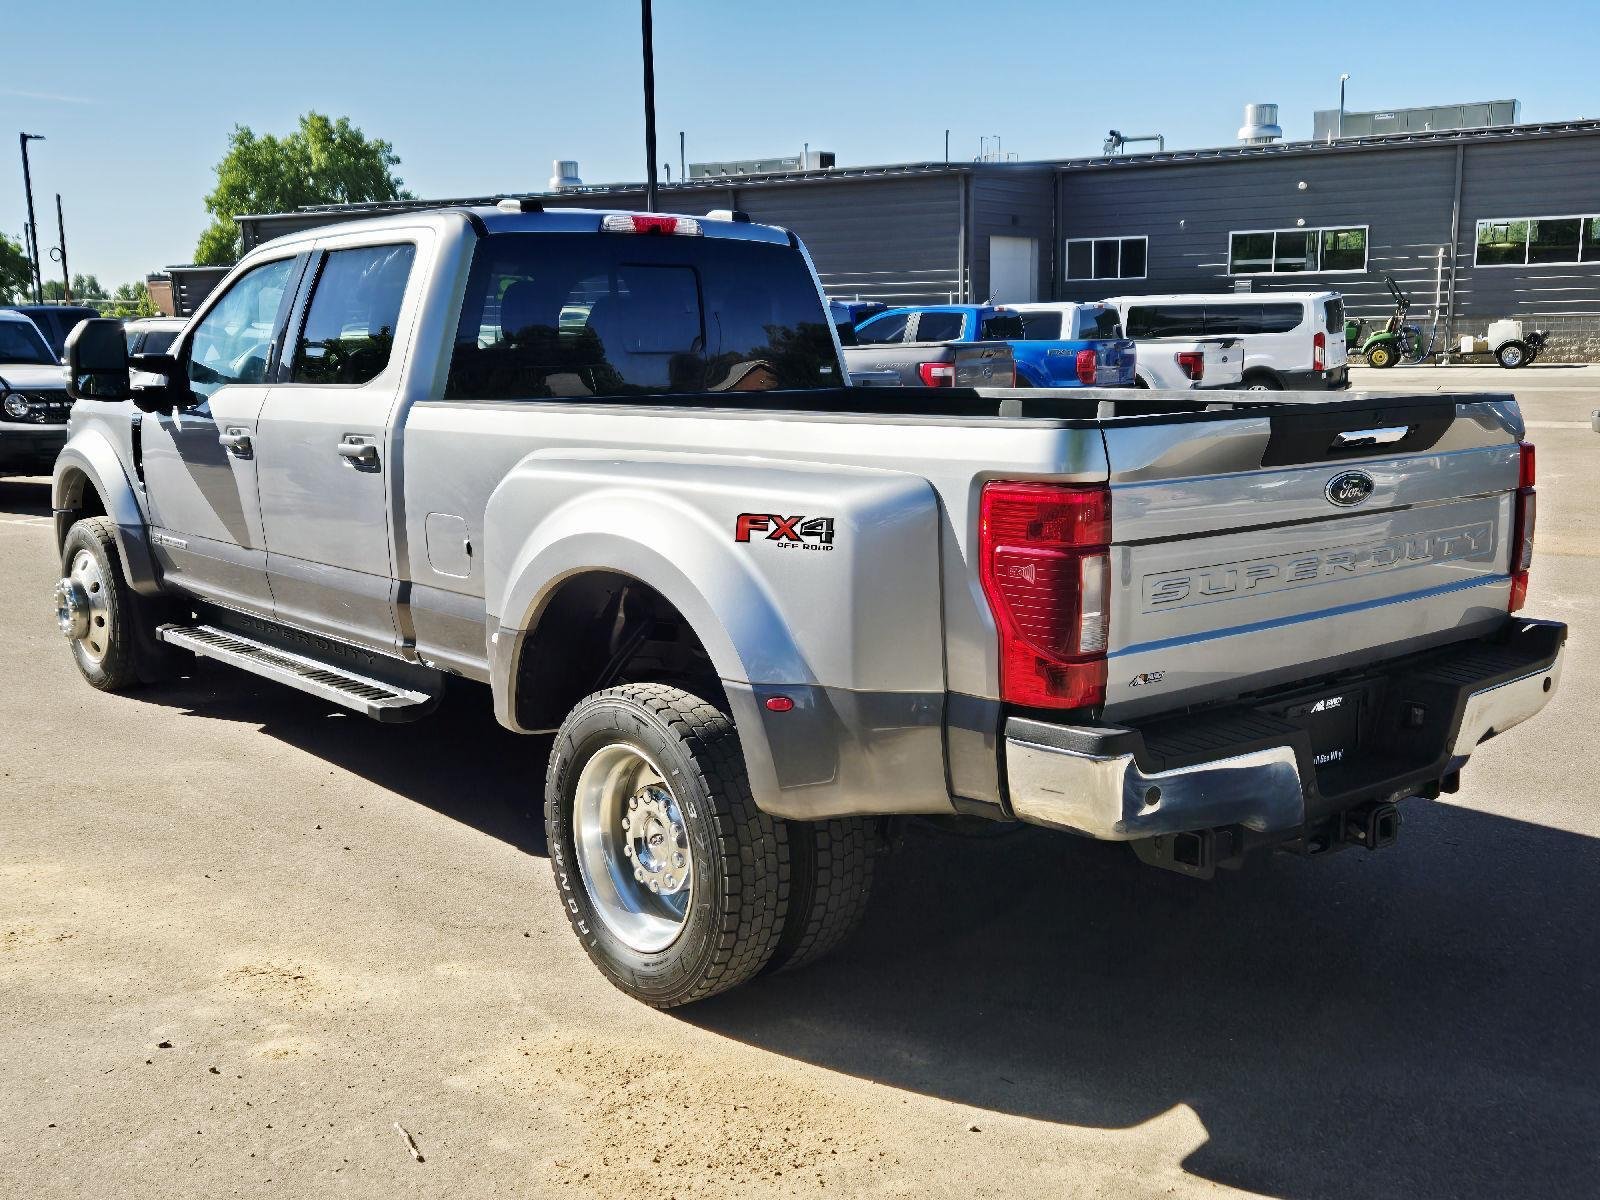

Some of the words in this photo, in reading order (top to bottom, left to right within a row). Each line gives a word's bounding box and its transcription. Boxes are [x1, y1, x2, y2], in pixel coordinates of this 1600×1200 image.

[1339, 479, 1367, 499] Ford
[734, 512, 835, 545] FX4
[776, 542, 799, 550] OFF
[802, 543, 834, 552] ROAD
[1151, 551, 1357, 605] SUPER
[1370, 528, 1489, 569] DUTY
[240, 616, 313, 647] SUPER
[315, 638, 377, 665] DUTY
